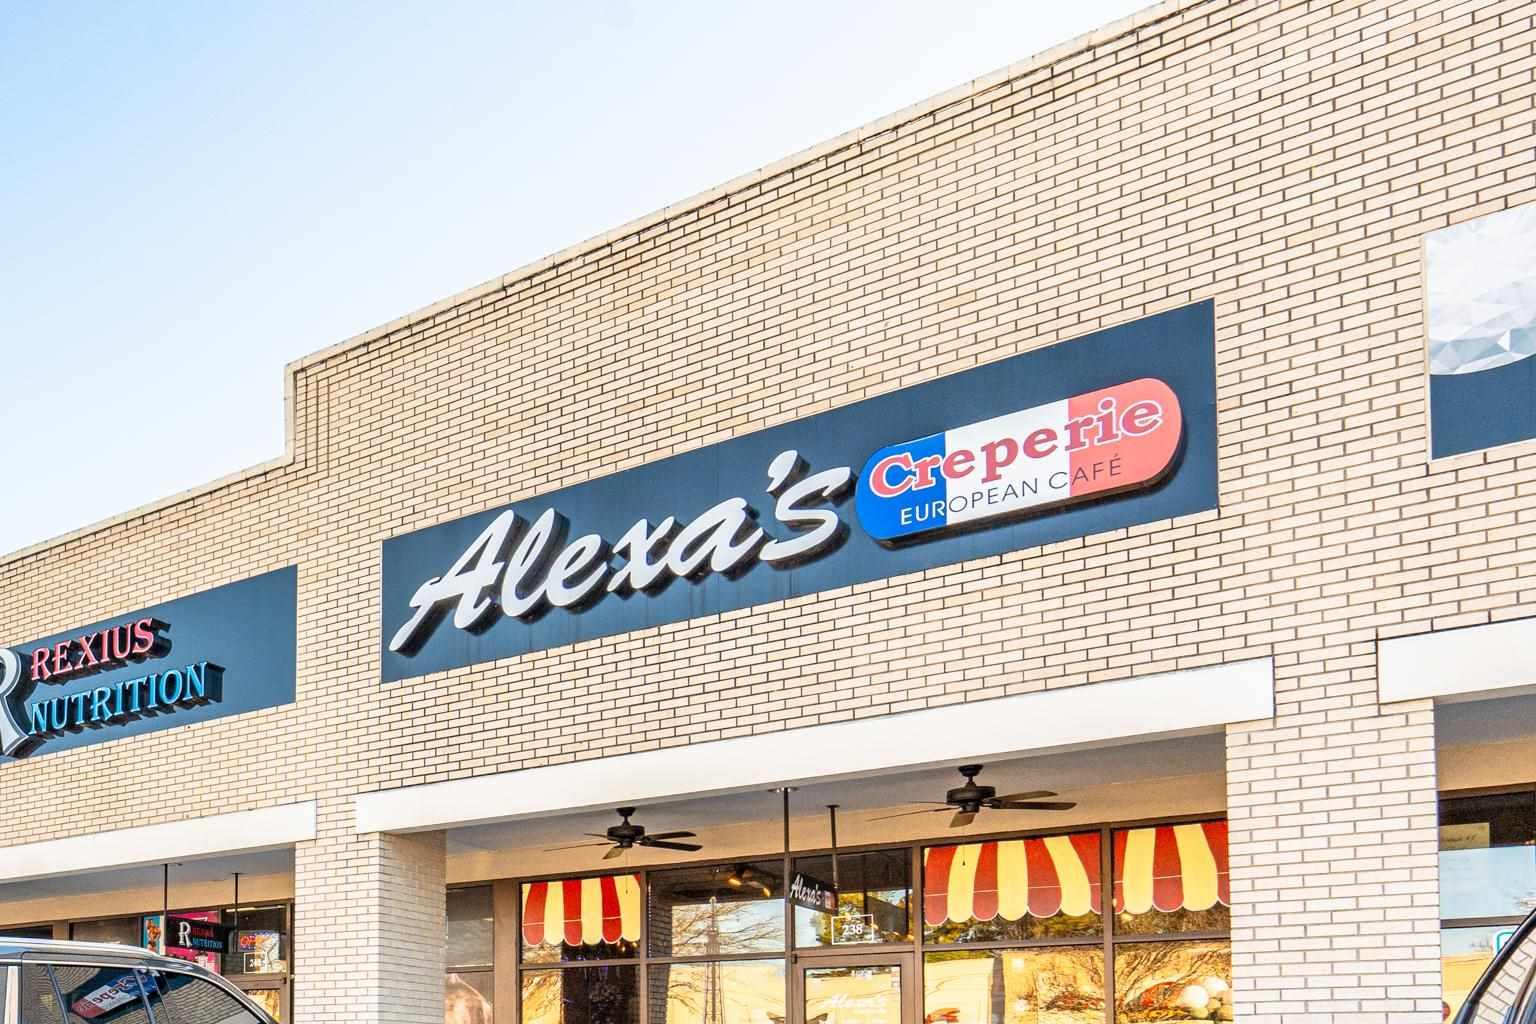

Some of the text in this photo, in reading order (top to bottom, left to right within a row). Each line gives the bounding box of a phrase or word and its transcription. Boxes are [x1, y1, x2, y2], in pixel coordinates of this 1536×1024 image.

[869, 396, 1163, 498] Creperie
[900, 453, 1123, 526] EUROPEAN CAFÉ
[389, 449, 852, 652] Alexa's
[31, 618, 160, 681] REXIUS
[29, 661, 210, 735] NUTRITION
[790, 873, 822, 905] Alexa's
[178, 921, 193, 948] R
[841, 924, 863, 936] 238
